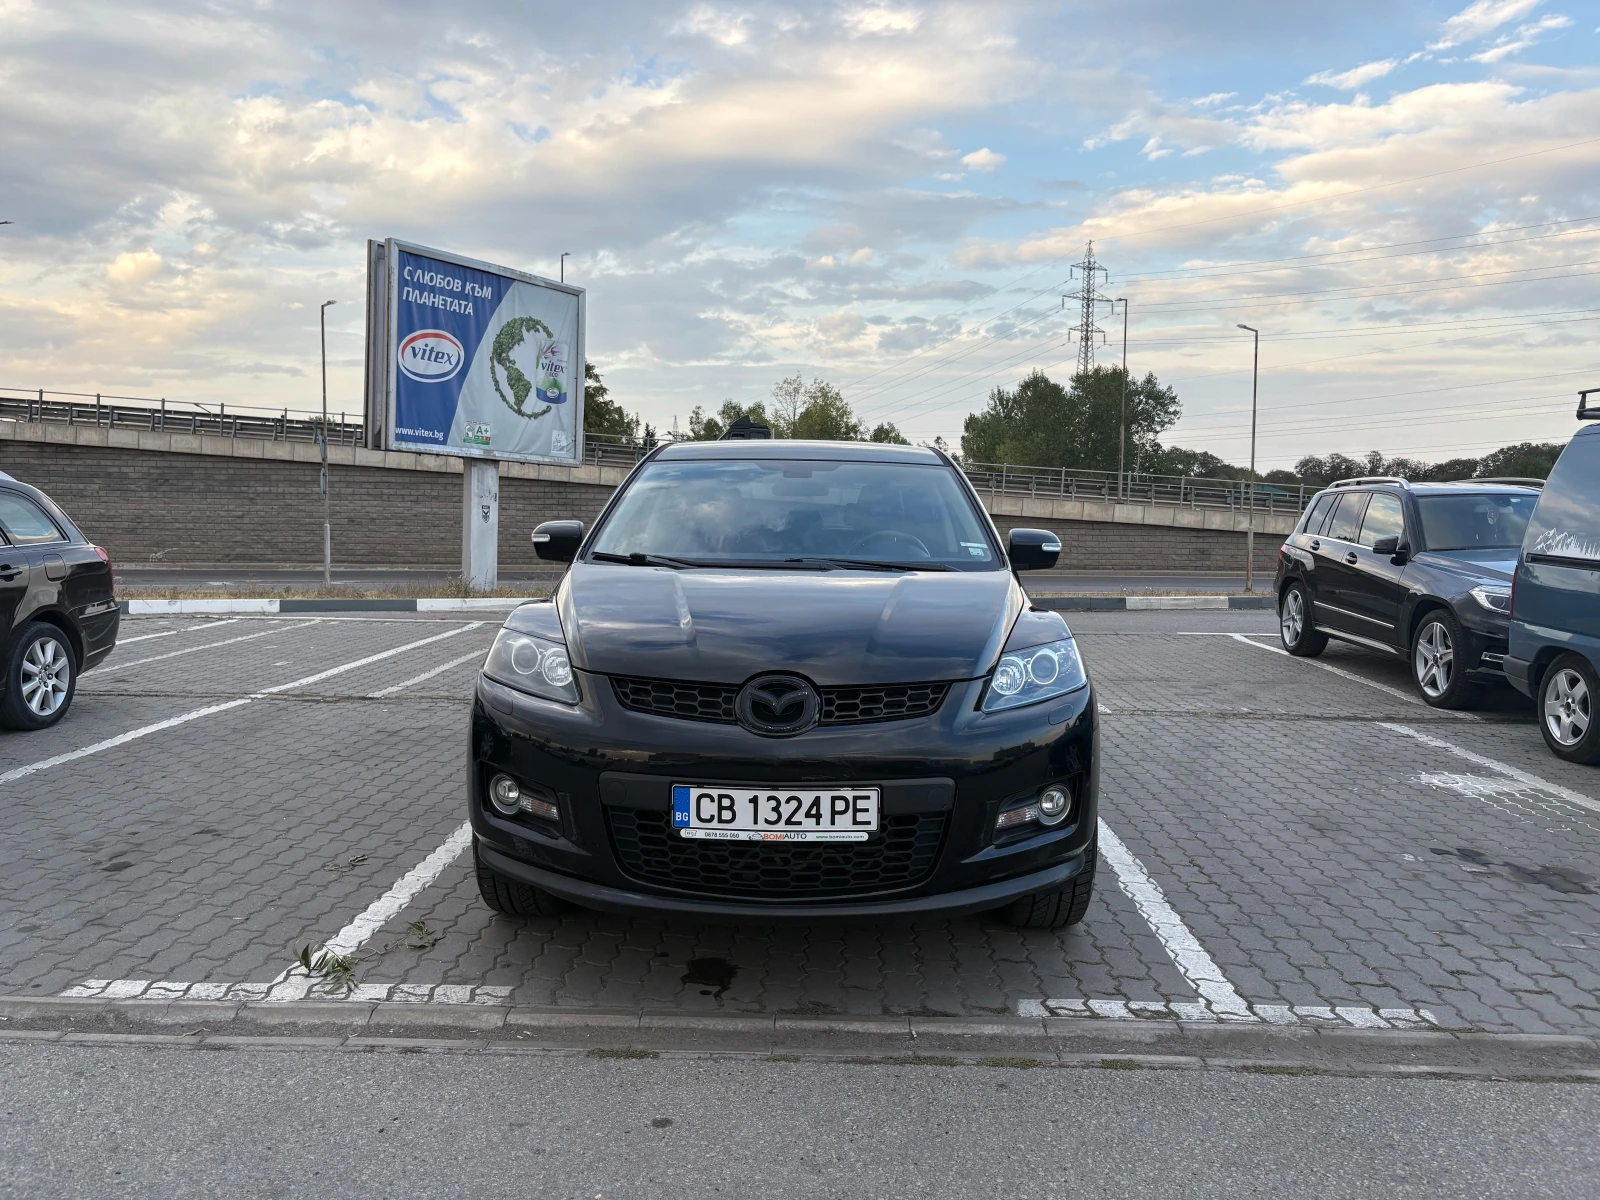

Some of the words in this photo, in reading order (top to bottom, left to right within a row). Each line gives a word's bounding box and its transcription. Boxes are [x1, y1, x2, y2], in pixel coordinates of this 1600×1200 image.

[404, 266, 412, 280] С
[413, 269, 462, 292] ЛЮБОВ
[465, 281, 492, 300] КЪМ
[402, 286, 474, 316] ПЛАНЕТАТА
[410, 343, 454, 366] vitex
[541, 360, 565, 374] vitex
[395, 427, 444, 441] www.vitex.bg
[475, 425, 489, 436] A+
[675, 811, 689, 821] BG
[695, 793, 737, 824] CB
[748, 794, 823, 826] 1324
[830, 795, 872, 826] PE
